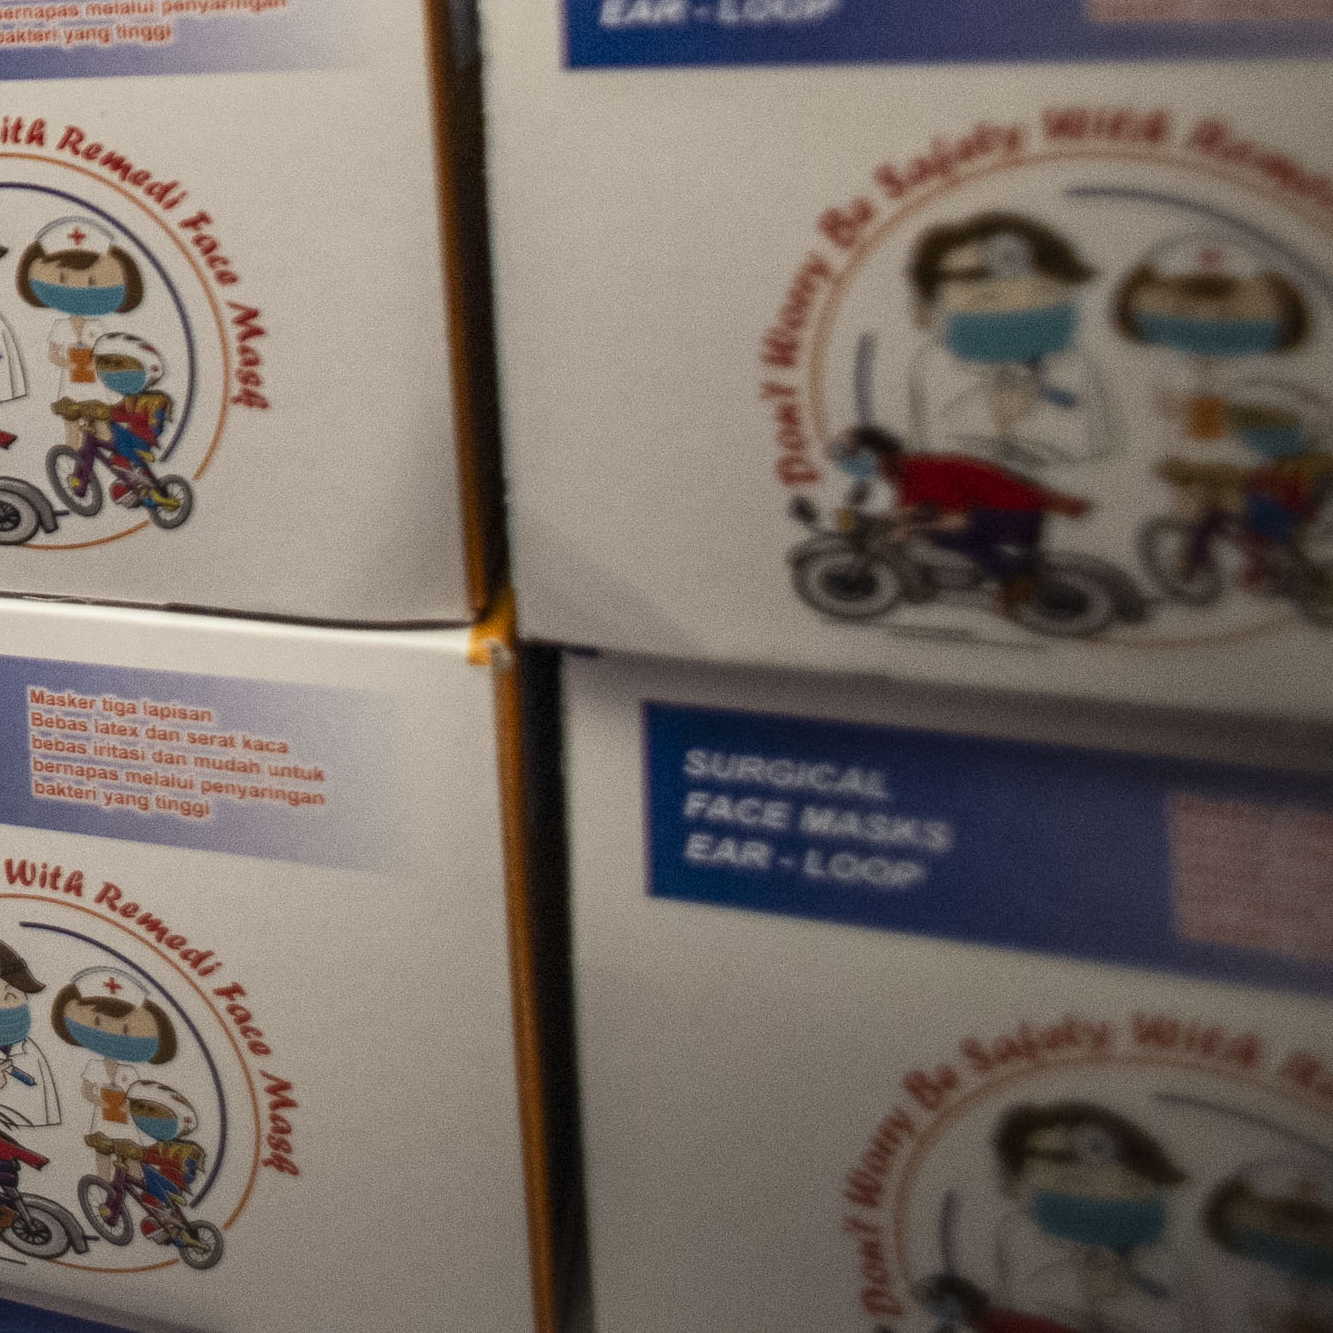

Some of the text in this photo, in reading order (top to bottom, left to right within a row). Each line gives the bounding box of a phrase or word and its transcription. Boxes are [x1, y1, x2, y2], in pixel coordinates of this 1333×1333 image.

[56, 126, 189, 212] Remedi
[178, 211, 240, 286] Face
[228, 301, 271, 410] Mask
[683, 749, 889, 800] SURGICAL
[683, 791, 951, 851] FACE MASKS
[684, 833, 772, 869] EAR
[803, 850, 924, 888] LOOP
